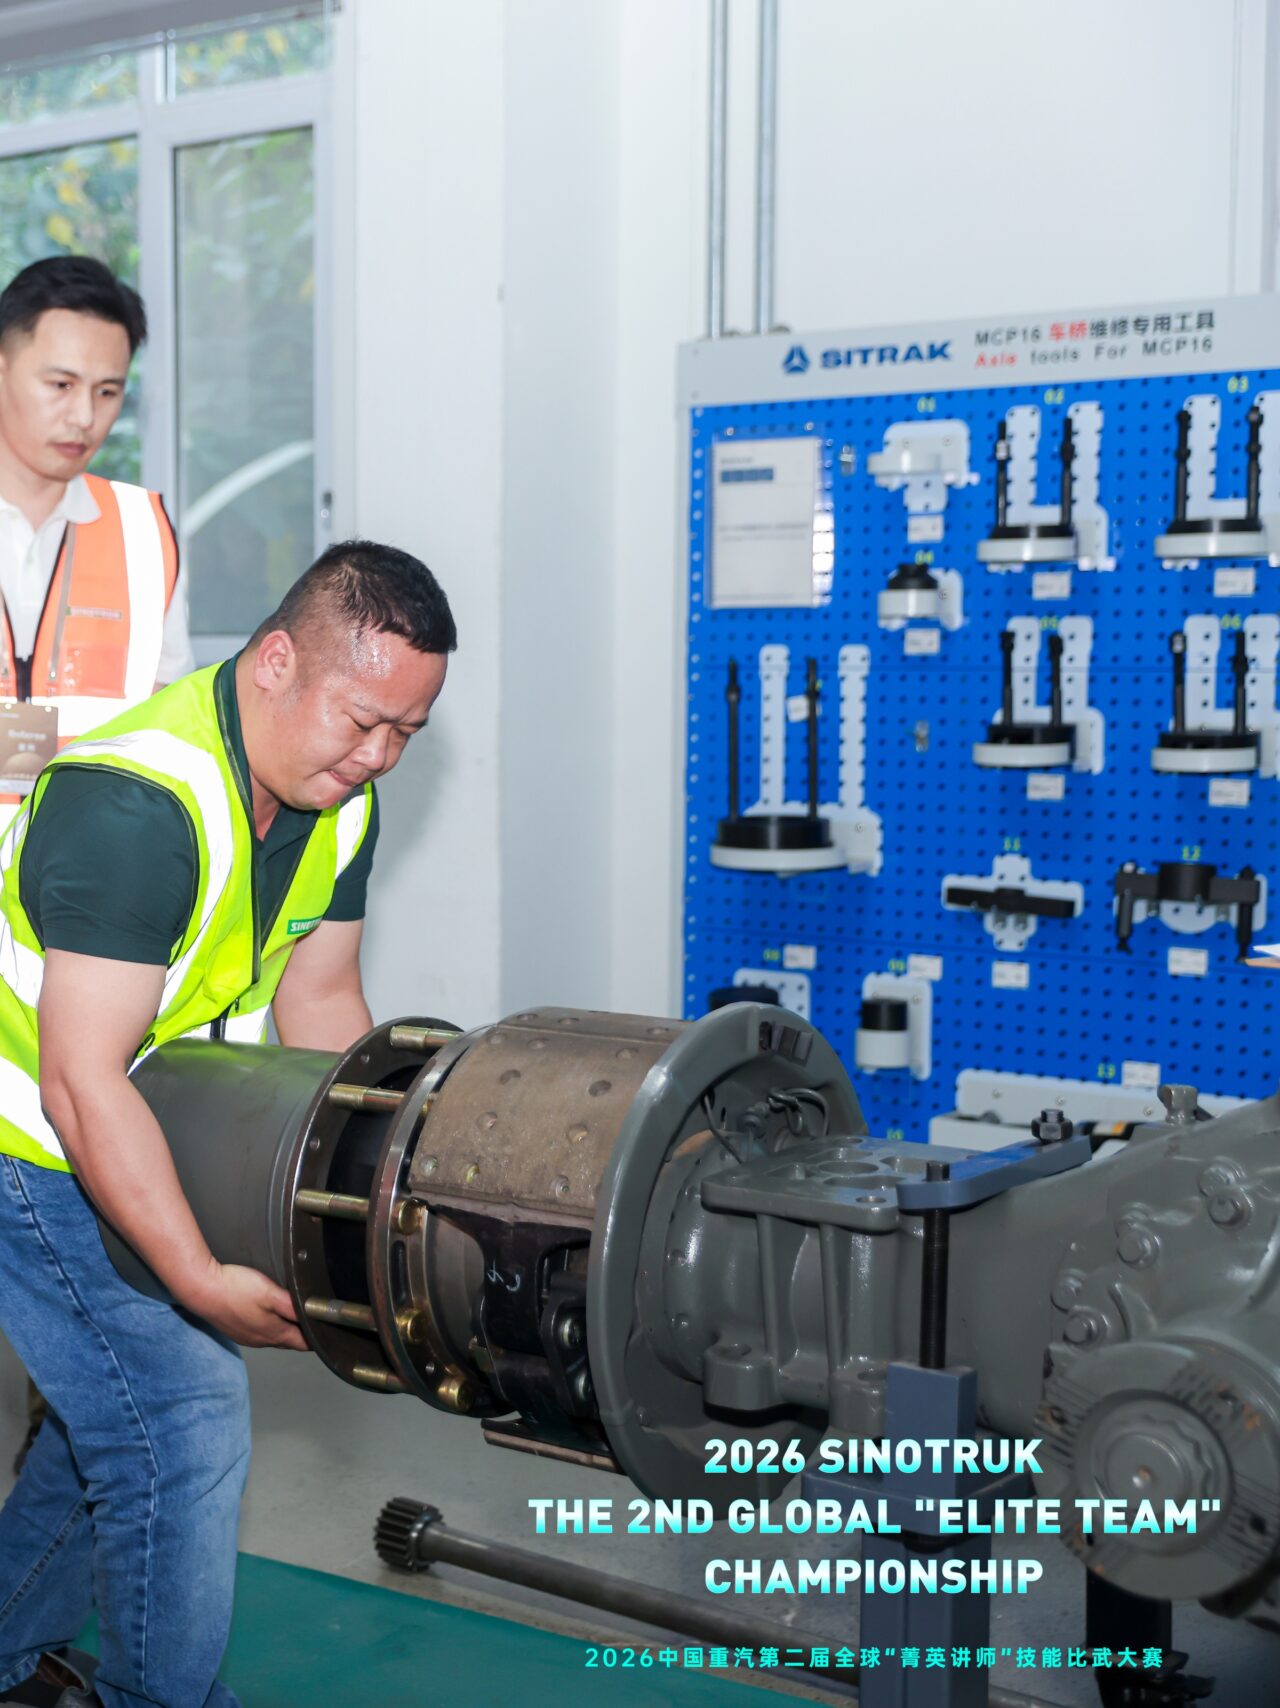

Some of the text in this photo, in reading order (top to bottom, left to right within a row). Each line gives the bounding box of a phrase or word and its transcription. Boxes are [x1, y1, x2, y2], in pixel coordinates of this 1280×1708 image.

[975, 311, 1215, 347] MCP16 车桥维修专用工具
[821, 340, 952, 369] SITRAK
[1030, 348, 1080, 365] tools
[1094, 343, 1128, 360] For
[1142, 337, 1214, 356] MCP16
